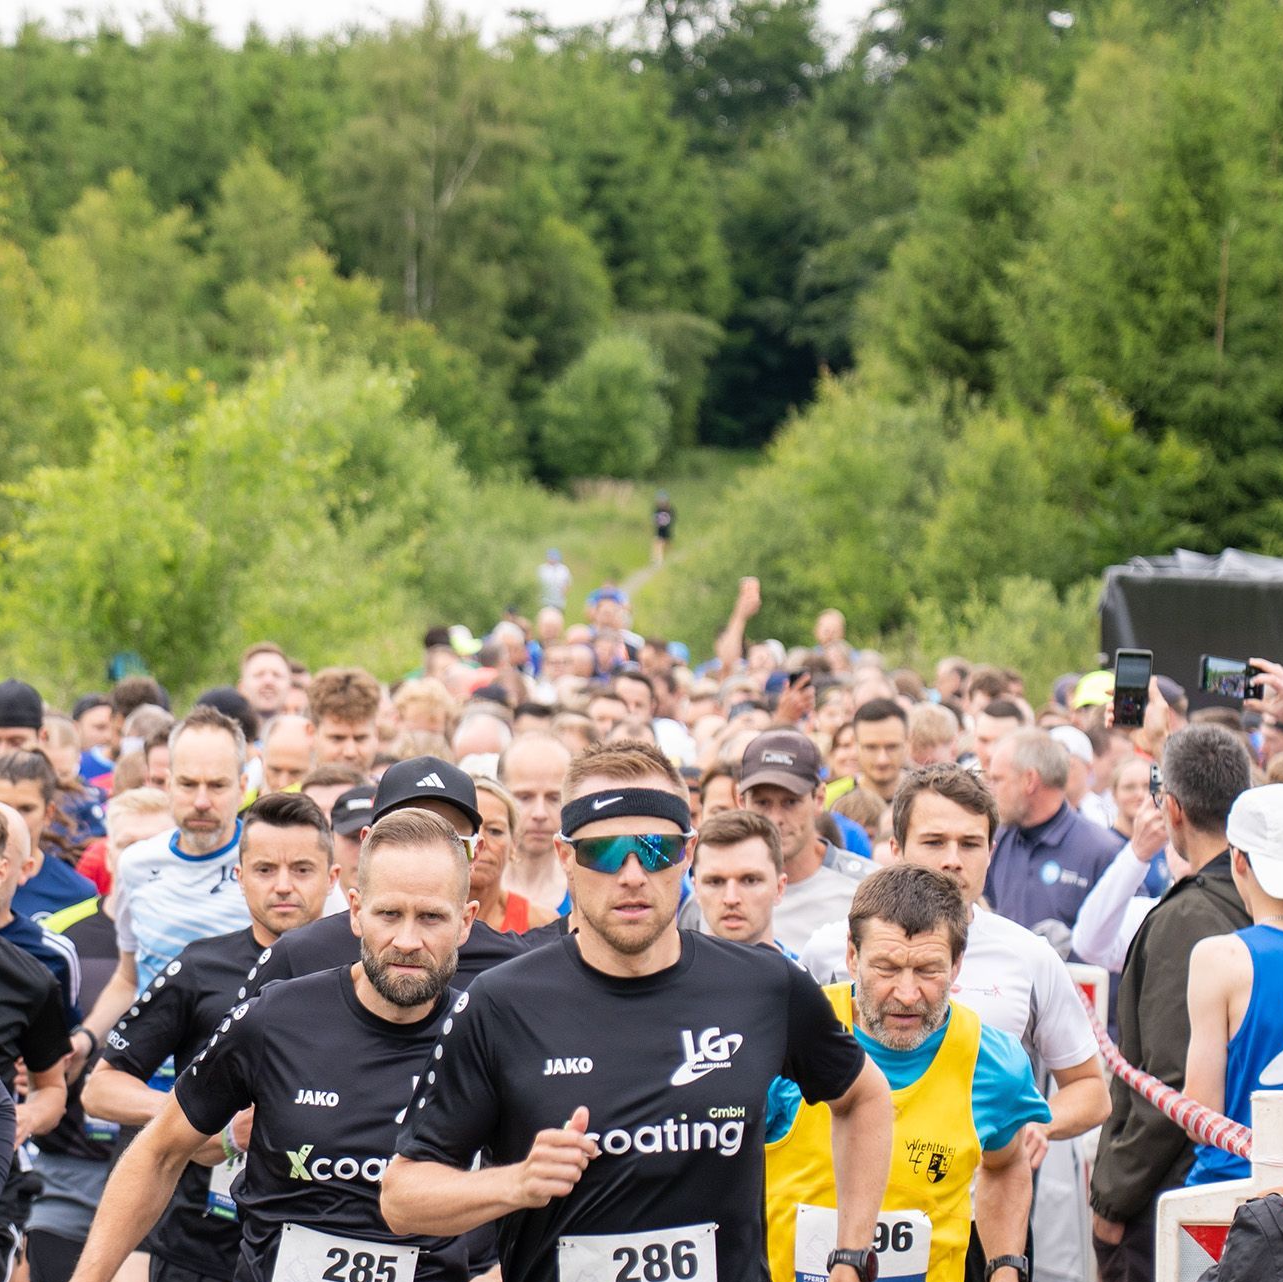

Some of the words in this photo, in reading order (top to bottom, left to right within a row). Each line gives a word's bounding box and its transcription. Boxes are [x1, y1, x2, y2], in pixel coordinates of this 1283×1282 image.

[543, 1057, 594, 1076] JAKO
[294, 1089, 340, 1107] JAKO
[709, 1107, 745, 1118] GmbH
